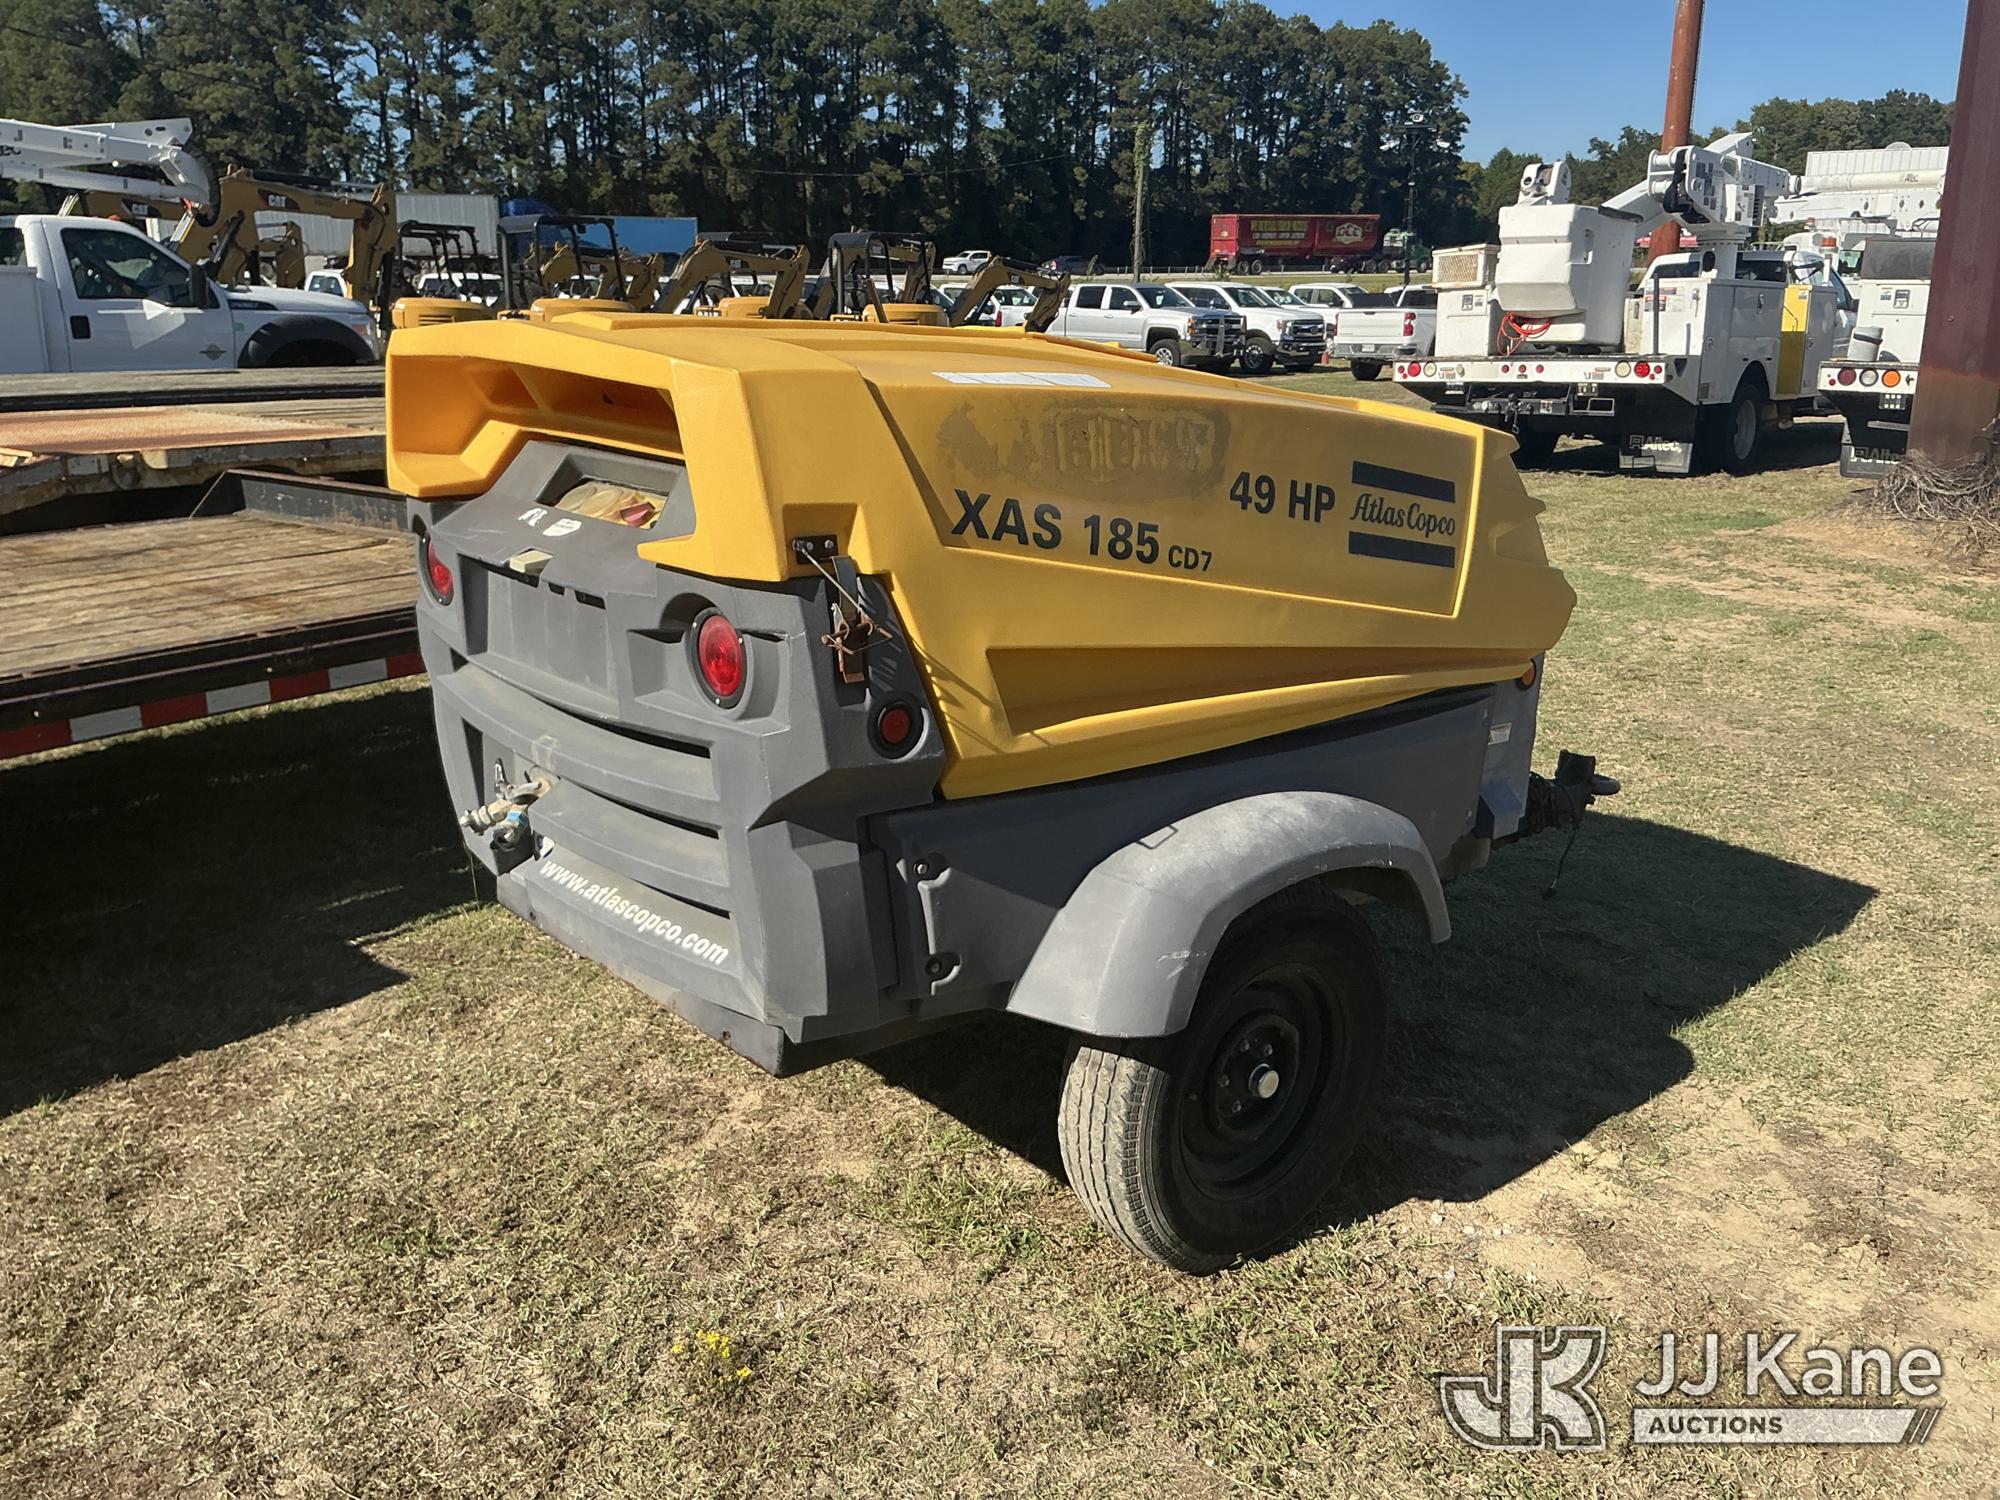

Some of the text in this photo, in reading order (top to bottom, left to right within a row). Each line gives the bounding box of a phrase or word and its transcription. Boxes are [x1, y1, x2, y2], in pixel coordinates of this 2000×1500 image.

[131, 203, 149, 215] CAT
[268, 194, 287, 208] CAT
[1229, 470, 1337, 523] 49 HP
[951, 488, 1213, 572] XAS 185 CD7
[539, 860, 731, 966] www.atlascopco.com
